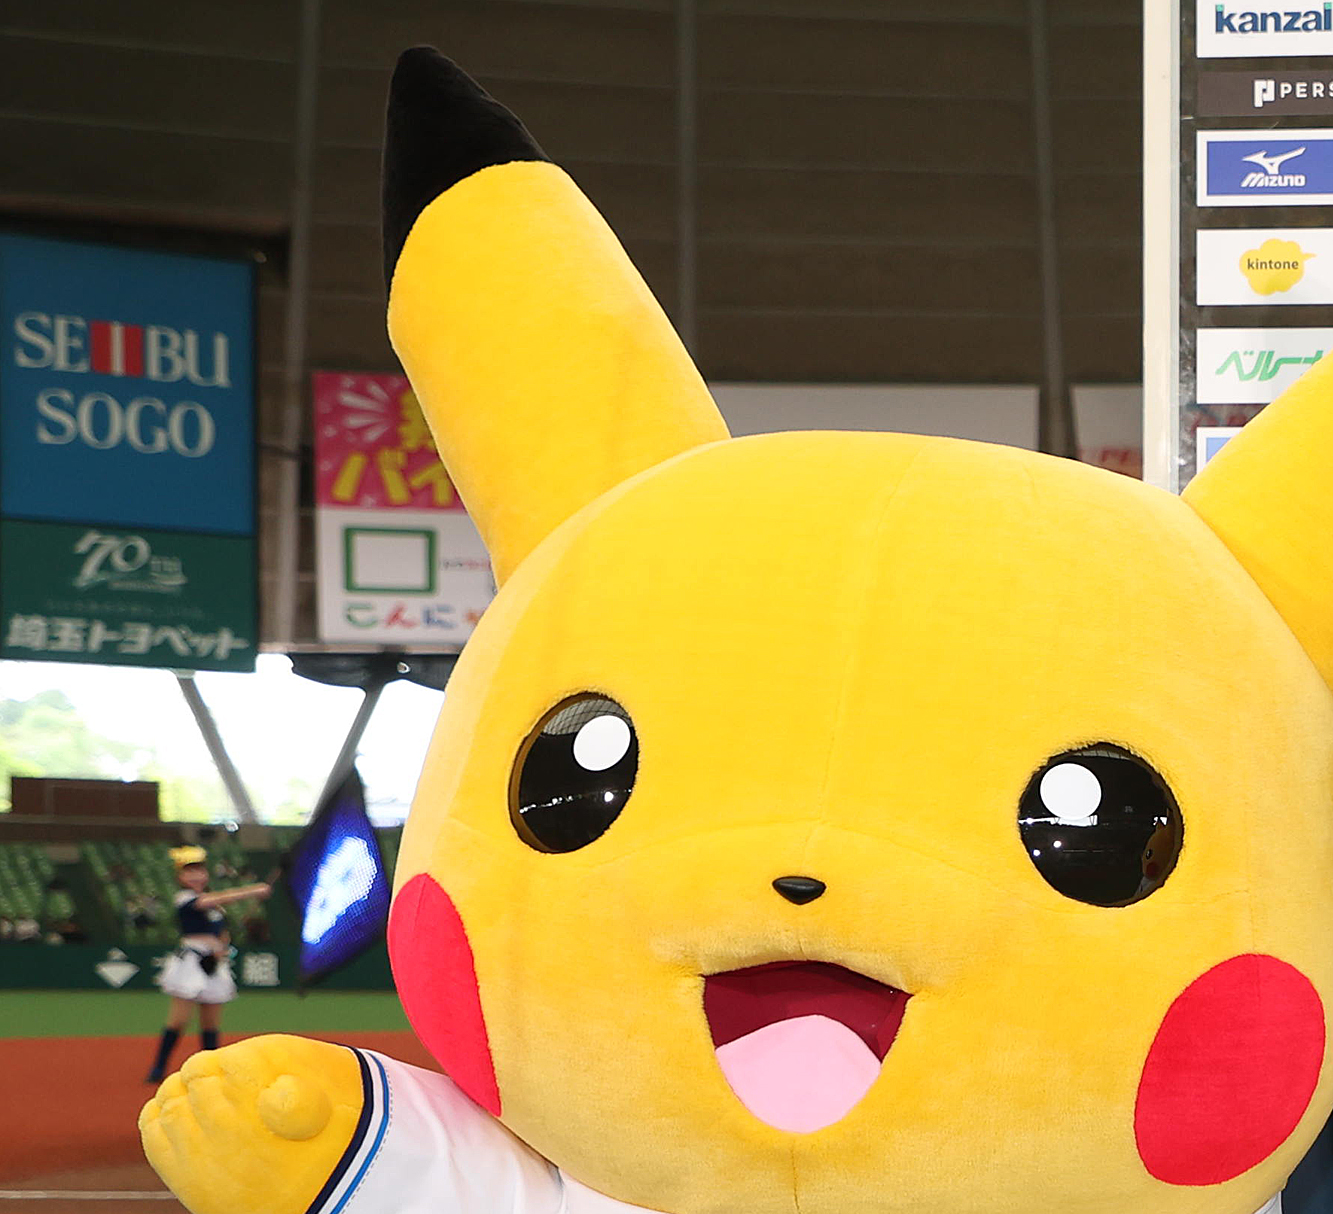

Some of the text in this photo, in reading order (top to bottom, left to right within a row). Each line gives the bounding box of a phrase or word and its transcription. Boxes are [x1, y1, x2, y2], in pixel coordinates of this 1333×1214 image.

[1214, 1, 1333, 34] kanzai
[1241, 170, 1305, 188] MIZUNO
[1247, 257, 1299, 270] kintone
[14, 311, 233, 389] SEIBU
[36, 389, 217, 458] SOGO
